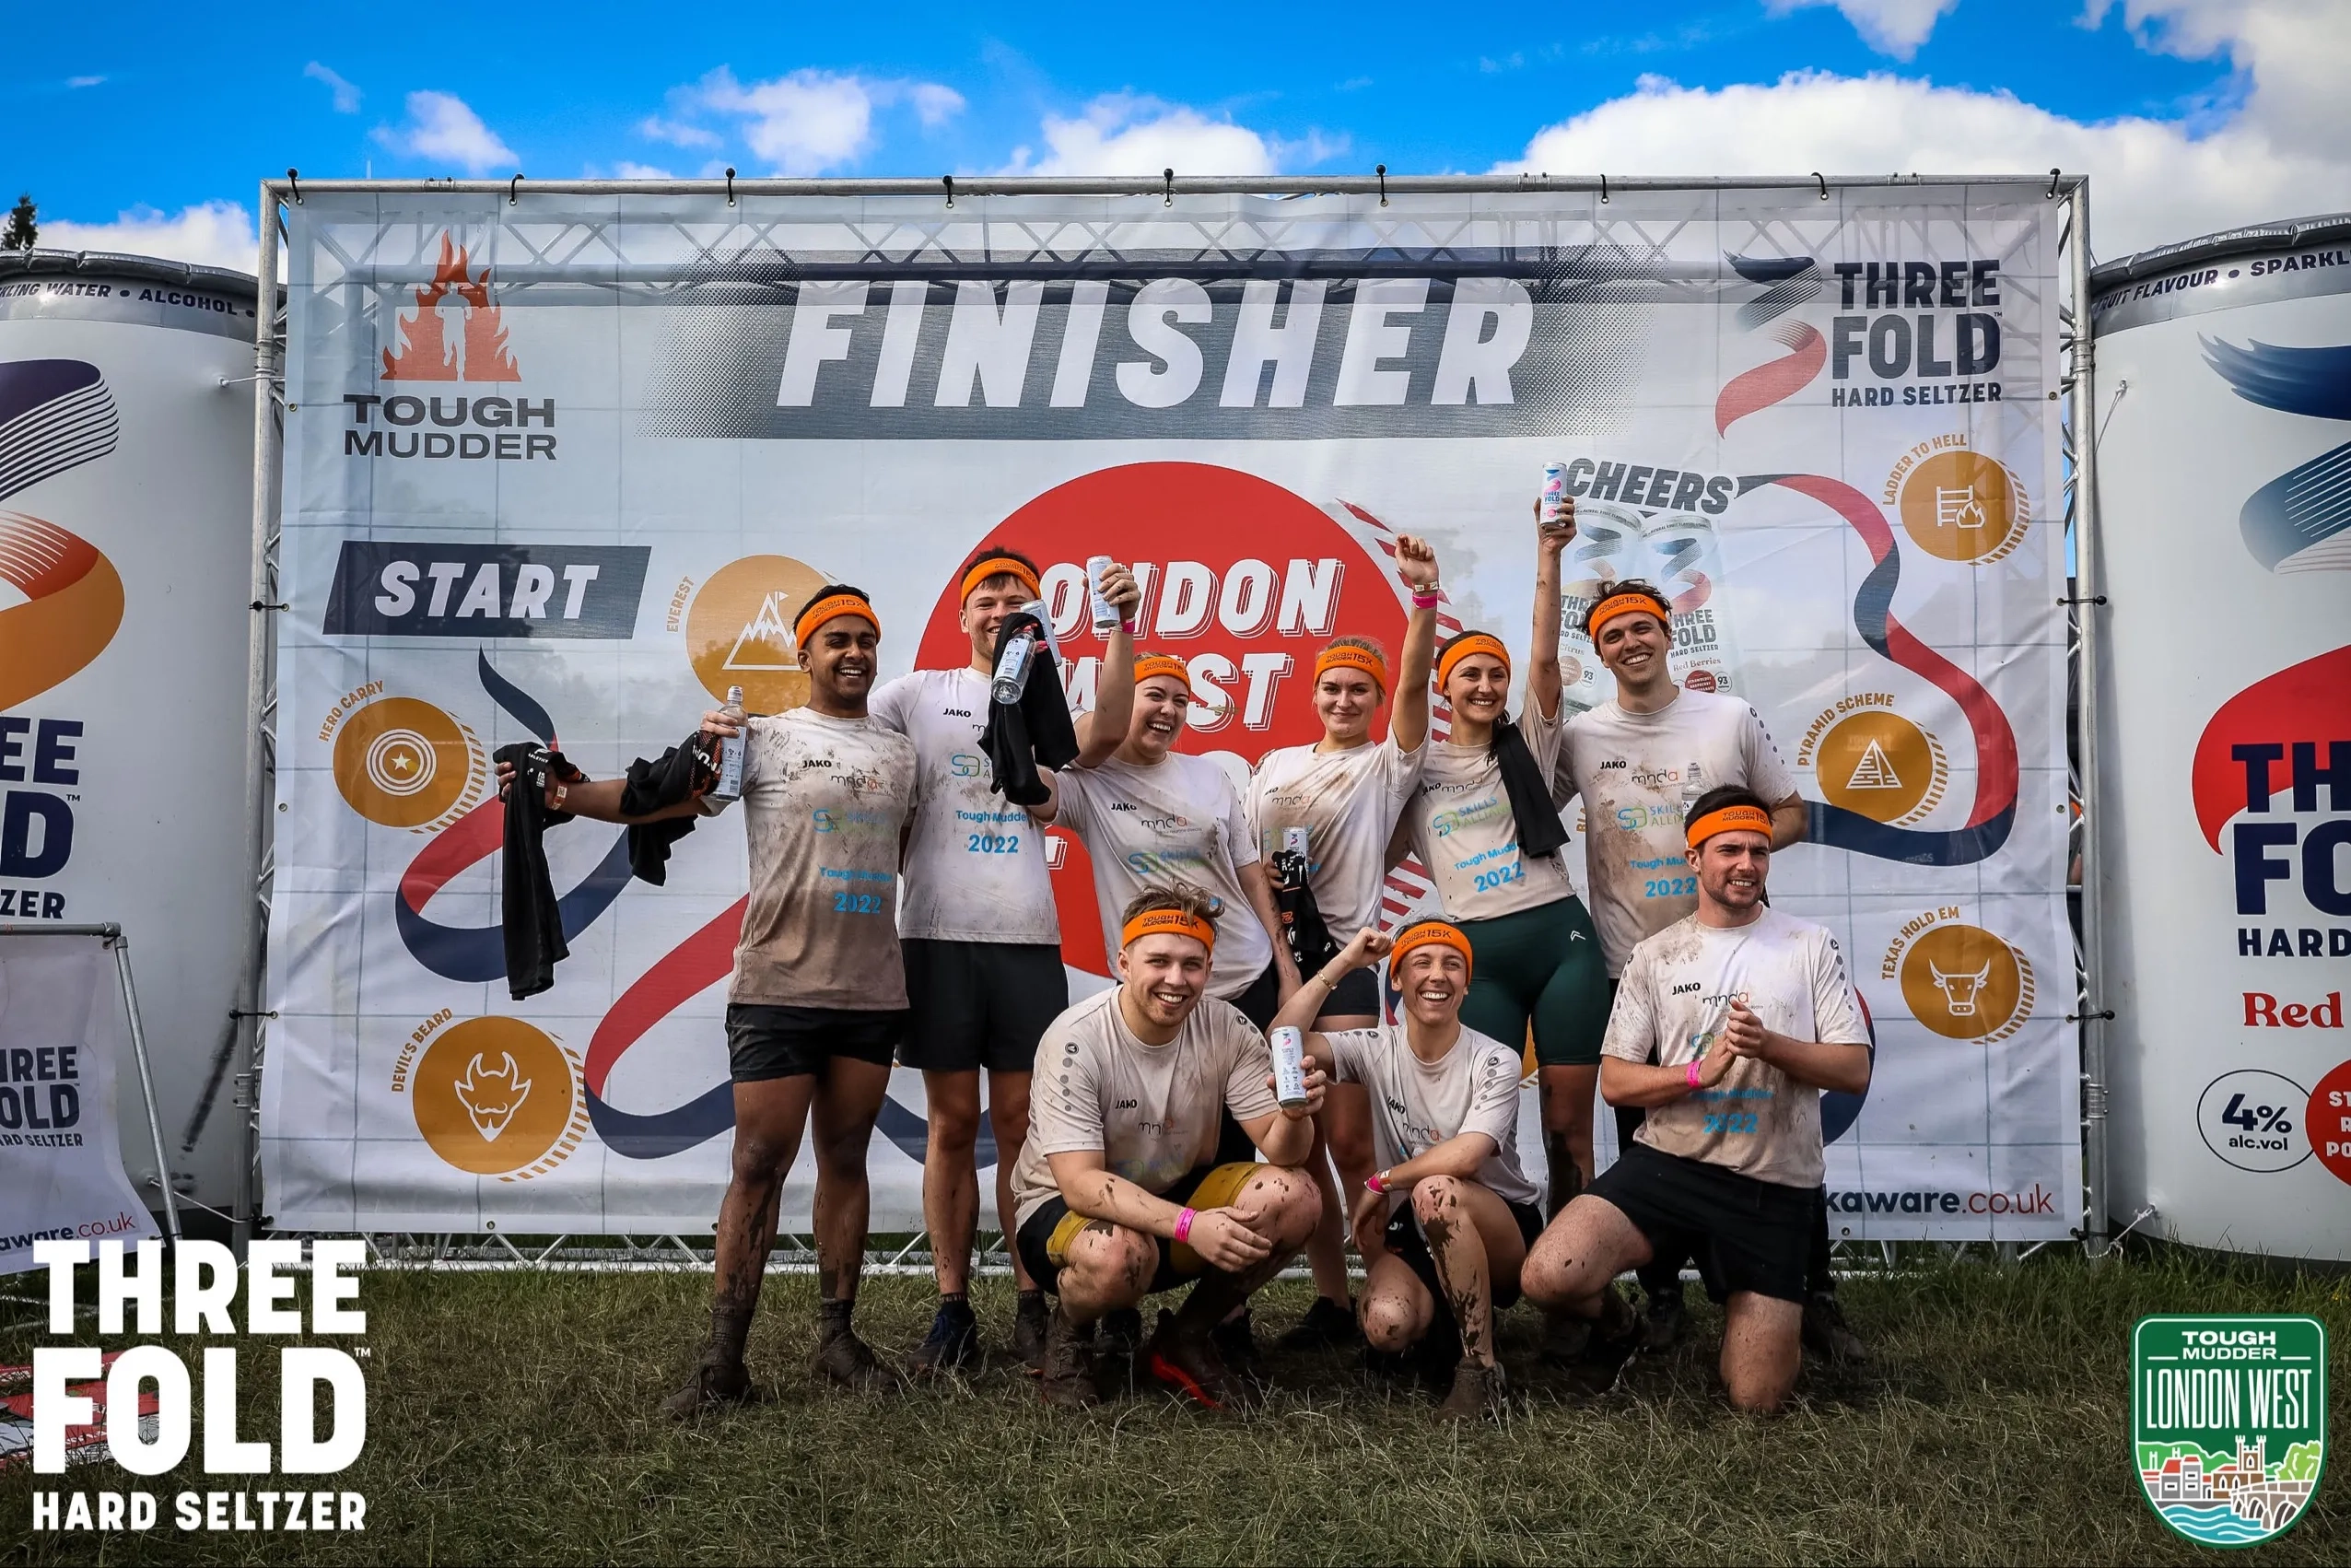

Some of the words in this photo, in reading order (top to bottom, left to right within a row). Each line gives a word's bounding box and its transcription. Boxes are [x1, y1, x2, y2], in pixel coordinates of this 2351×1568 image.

[2251, 250, 2351, 276] SPARKL
[47, 283, 111, 298] WATER
[1833, 259, 2000, 310] THREE
[2133, 269, 2218, 301] FLAVOUR
[138, 288, 238, 316] ALCOHOL
[776, 277, 1535, 408] FINISHER
[1831, 313, 2000, 380] FOLD
[1831, 386, 1894, 408] HARD
[1902, 382, 2003, 406] SELTZER
[343, 393, 556, 428] TOUGH
[344, 429, 557, 461] MUDDER
[1882, 457, 1915, 507] LADDER
[1911, 440, 1931, 459] TO
[1932, 433, 1968, 449] HELL
[1567, 458, 1733, 515] CHEERS
[373, 558, 601, 618] START
[666, 575, 696, 635] EVEREST
[1039, 557, 1346, 642] ONDON
[1561, 595, 1588, 612] THR
[1625, 596, 1647, 605] 15K
[1673, 609, 1714, 628] HREE
[1352, 653, 1373, 667] 15K
[1671, 649, 1689, 659] HARD
[1690, 644, 1720, 654] SELTZER
[1673, 661, 1689, 672] Red
[1690, 657, 1722, 668] Berries
[1585, 670, 1595, 681] 93
[1718, 676, 1728, 685] 93
[318, 707, 344, 743] HERO
[339, 680, 385, 711] CARRY
[943, 708, 971, 718] JAKO
[1797, 708, 1837, 767] PYRAMID
[1835, 692, 1895, 715] SCHEME
[802, 759, 832, 768] JAKO
[1600, 760, 1627, 770] JAKO
[1632, 769, 1678, 785] mnda
[1272, 793, 1311, 807] mnda
[1459, 796, 1498, 818] SKILLS
[955, 810, 990, 823] Tough
[1141, 813, 1187, 829] mnda
[968, 834, 1019, 853] 2022
[1455, 853, 1487, 872] Tough
[1487, 841, 1518, 859] Mudd
[1630, 856, 1664, 870] Tough
[1474, 860, 1526, 893] 2022
[1644, 876, 1697, 897] 2022
[834, 892, 883, 914] 2022
[1142, 919, 1173, 928] MUDDER
[1427, 929, 1452, 939] 15K
[1882, 938, 1906, 980] TEXAS
[1900, 910, 1936, 940] HOLD
[1938, 906, 1960, 921] EM
[2238, 928, 2351, 957] HARD
[1672, 982, 1701, 995] JAKO
[1702, 989, 1749, 1007] mnda
[2242, 991, 2345, 1028] Red
[392, 1042, 417, 1093] DEVIL'S
[412, 1007, 453, 1044] BEARD
[1115, 1099, 1138, 1109] JAKO
[1387, 1096, 1406, 1115] JAKO
[2221, 1093, 2293, 1133] 4%
[1703, 1113, 1760, 1134] 2022
[25, 1133, 83, 1147] SELTZER
[2228, 1135, 2288, 1151] alc.vol
